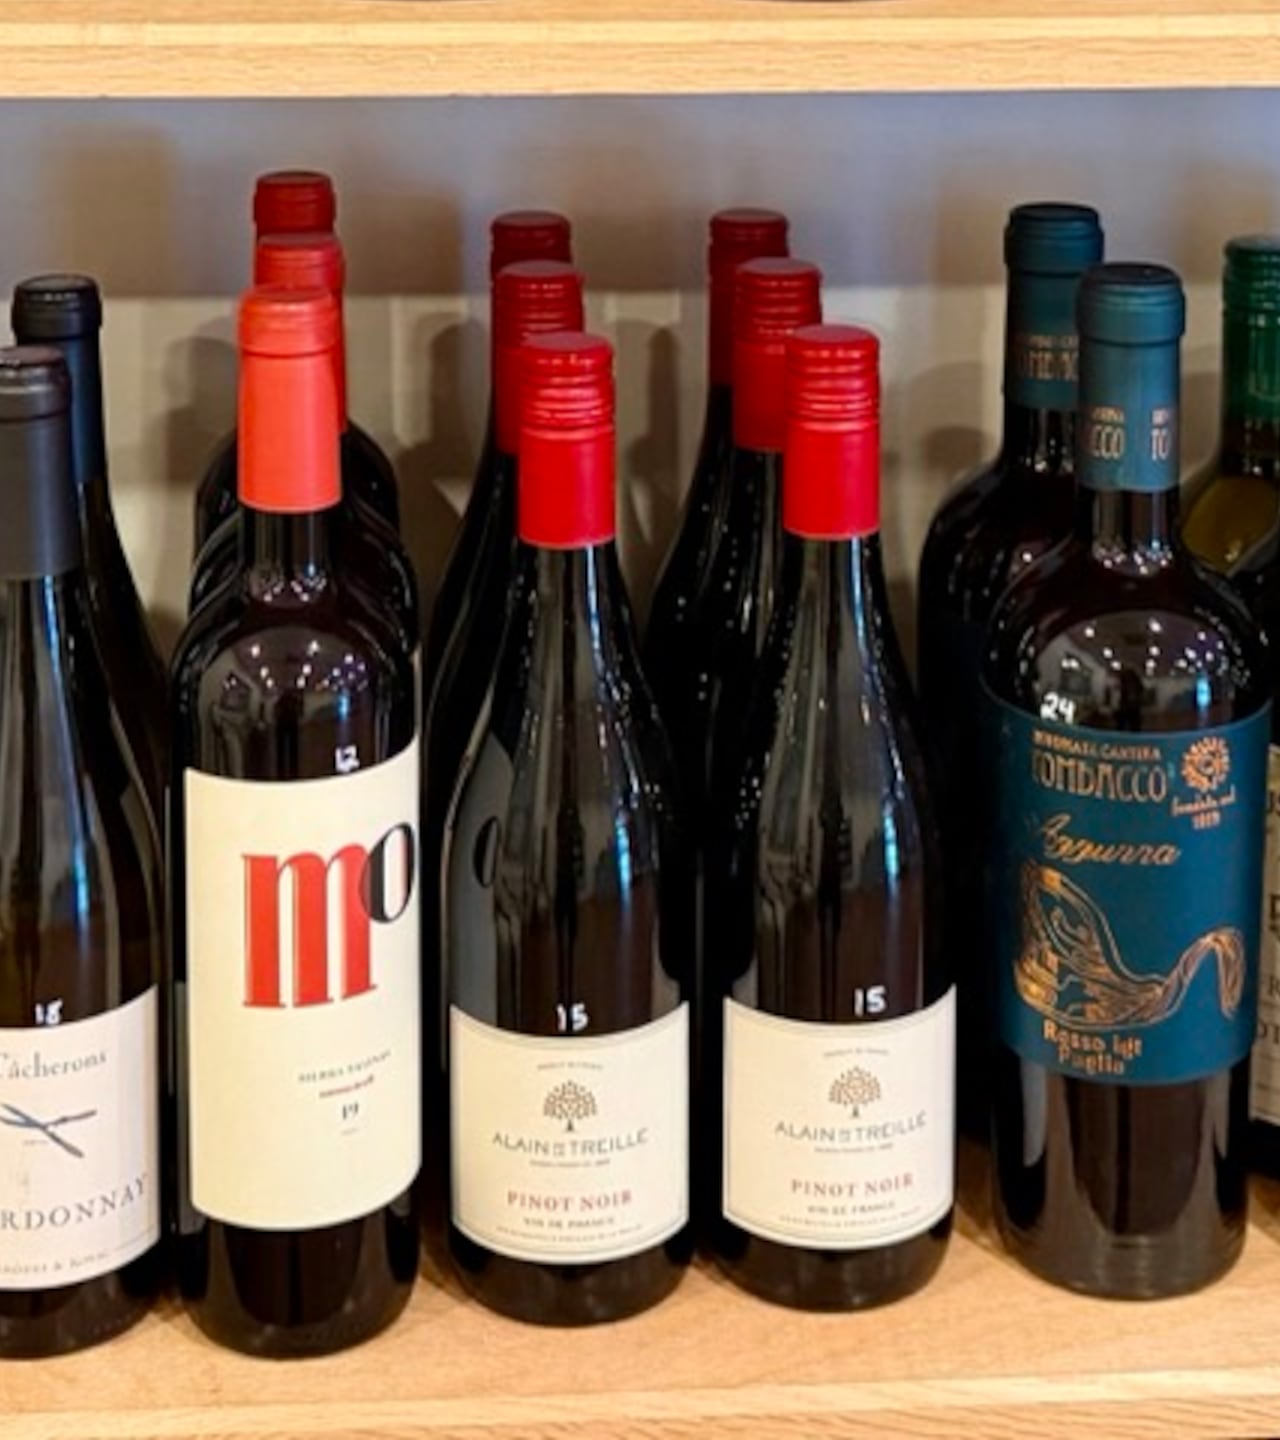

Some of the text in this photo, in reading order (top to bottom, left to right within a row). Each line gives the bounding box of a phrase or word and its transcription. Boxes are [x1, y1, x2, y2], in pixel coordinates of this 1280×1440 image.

[1041, 692, 1075, 723] 24
[854, 985, 886, 1017] 15
[557, 1003, 588, 1031] 15
[1044, 1019, 1106, 1054] Rosso
[775, 1111, 927, 1143] ALAIN TREILLE
[492, 1128, 649, 1156] ALAIN TREILLE
[791, 1172, 914, 1198] PINOT NOIR
[507, 1190, 632, 1212] PINOT NOIR
